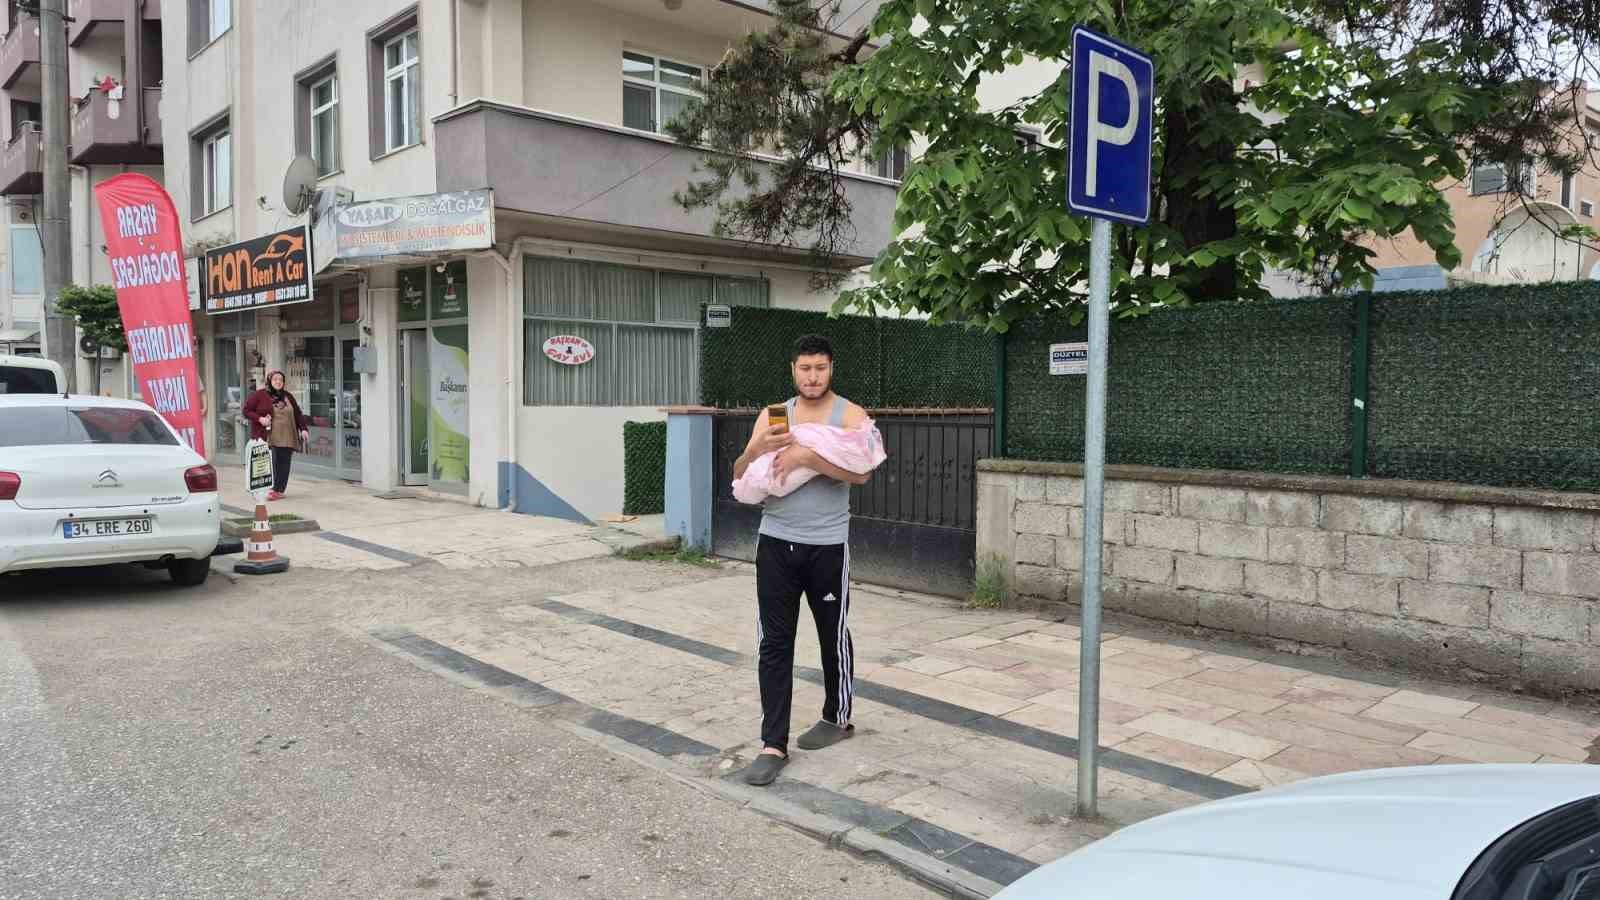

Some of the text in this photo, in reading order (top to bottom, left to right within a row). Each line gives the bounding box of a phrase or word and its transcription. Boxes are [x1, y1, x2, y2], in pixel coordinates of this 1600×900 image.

[1085, 50, 1140, 197] P
[252, 259, 304, 288] Rent A Car
[72, 519, 150, 536] 34 ERE 260
